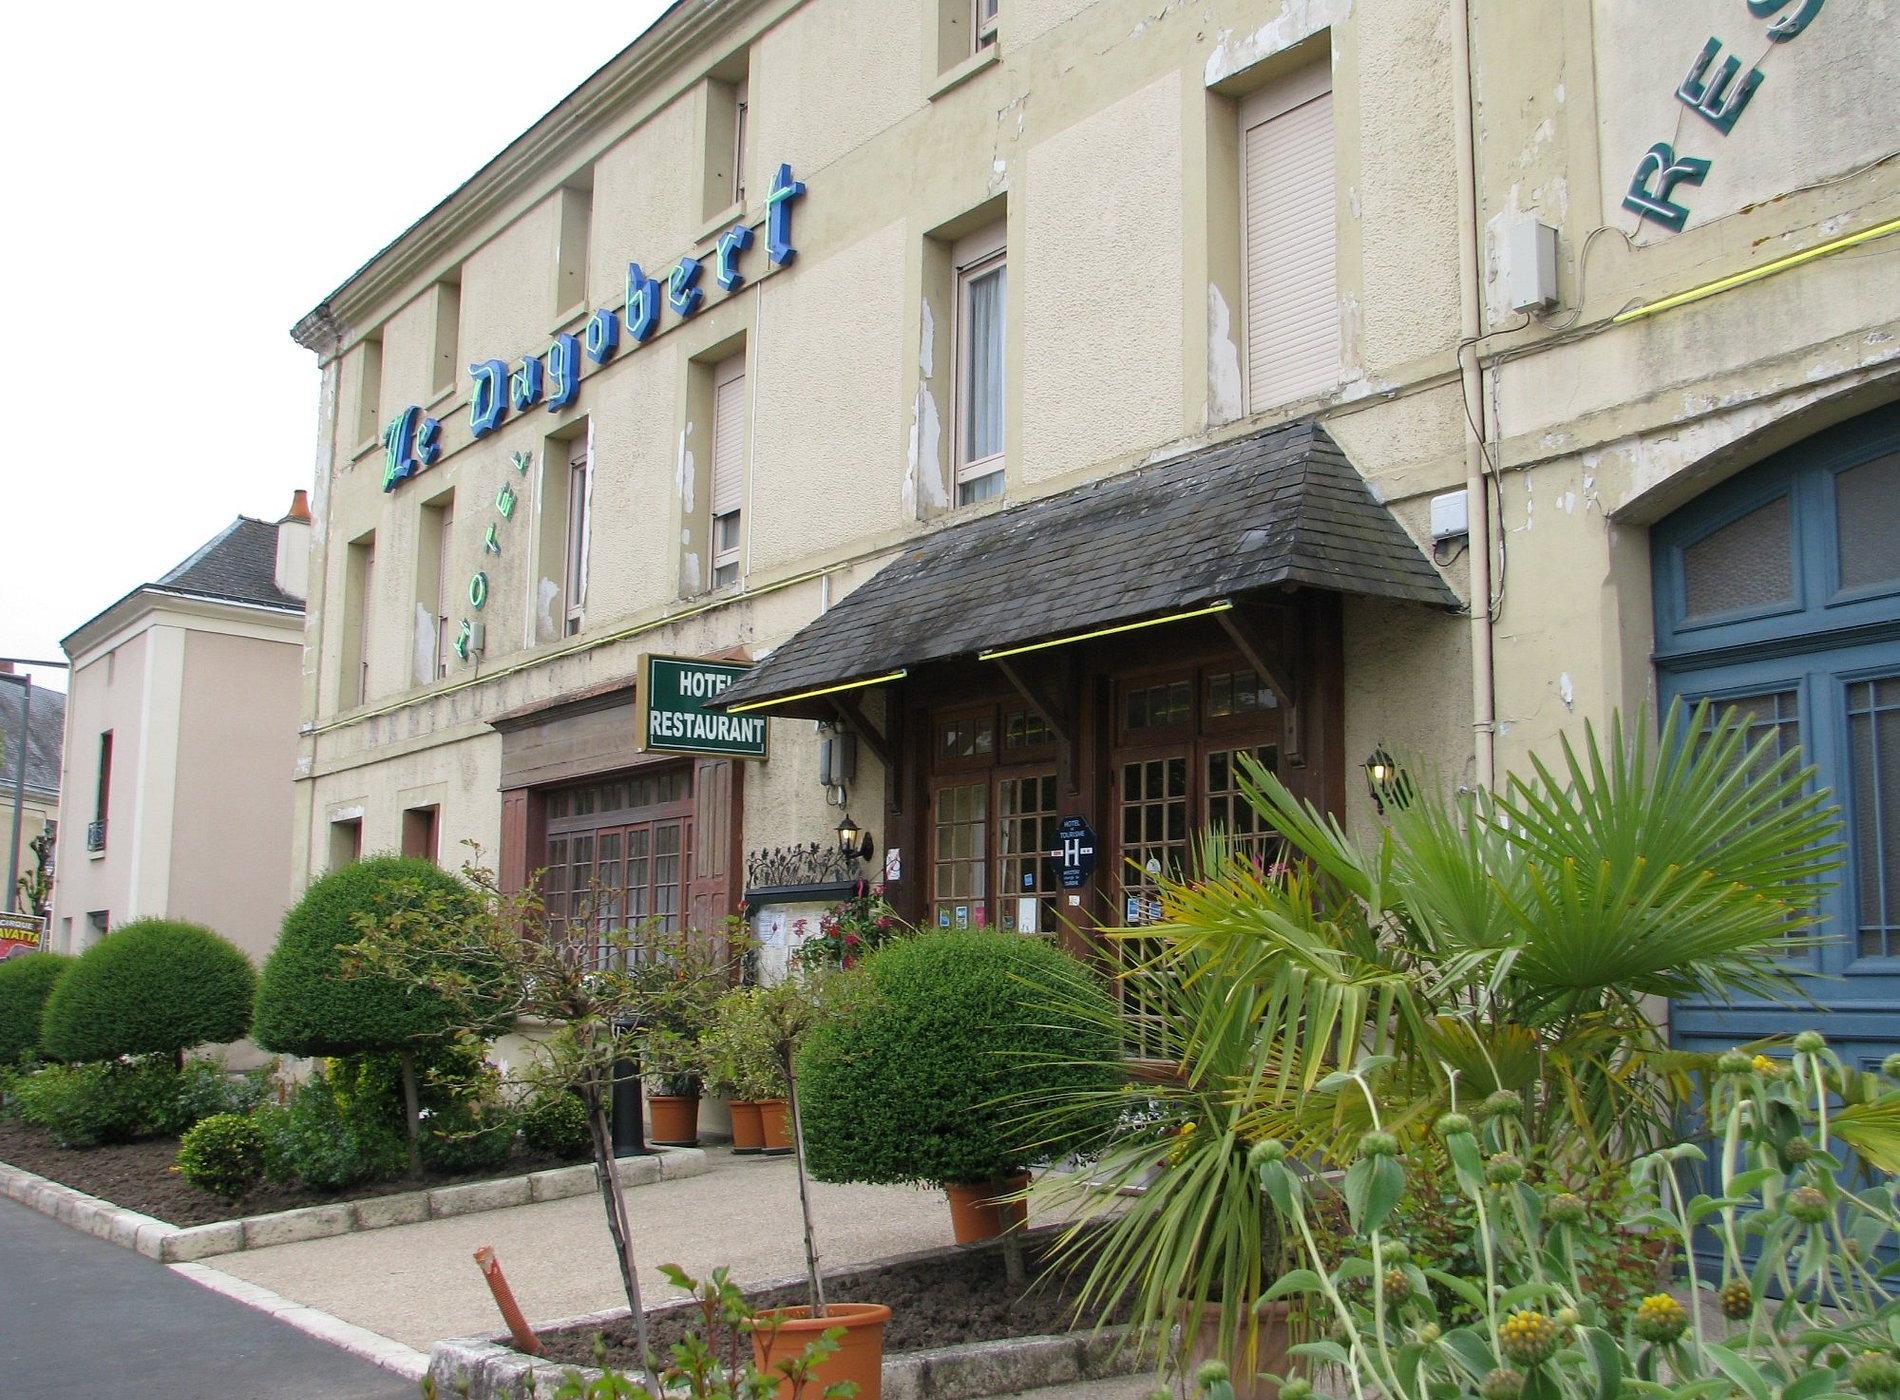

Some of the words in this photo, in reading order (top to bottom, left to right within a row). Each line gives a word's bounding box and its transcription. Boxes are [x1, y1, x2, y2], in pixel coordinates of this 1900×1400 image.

[382, 405, 442, 493] Le
[467, 163, 806, 440] Dagobert
[650, 710, 764, 743] RESTAURANT
[1064, 838, 1080, 867] H
